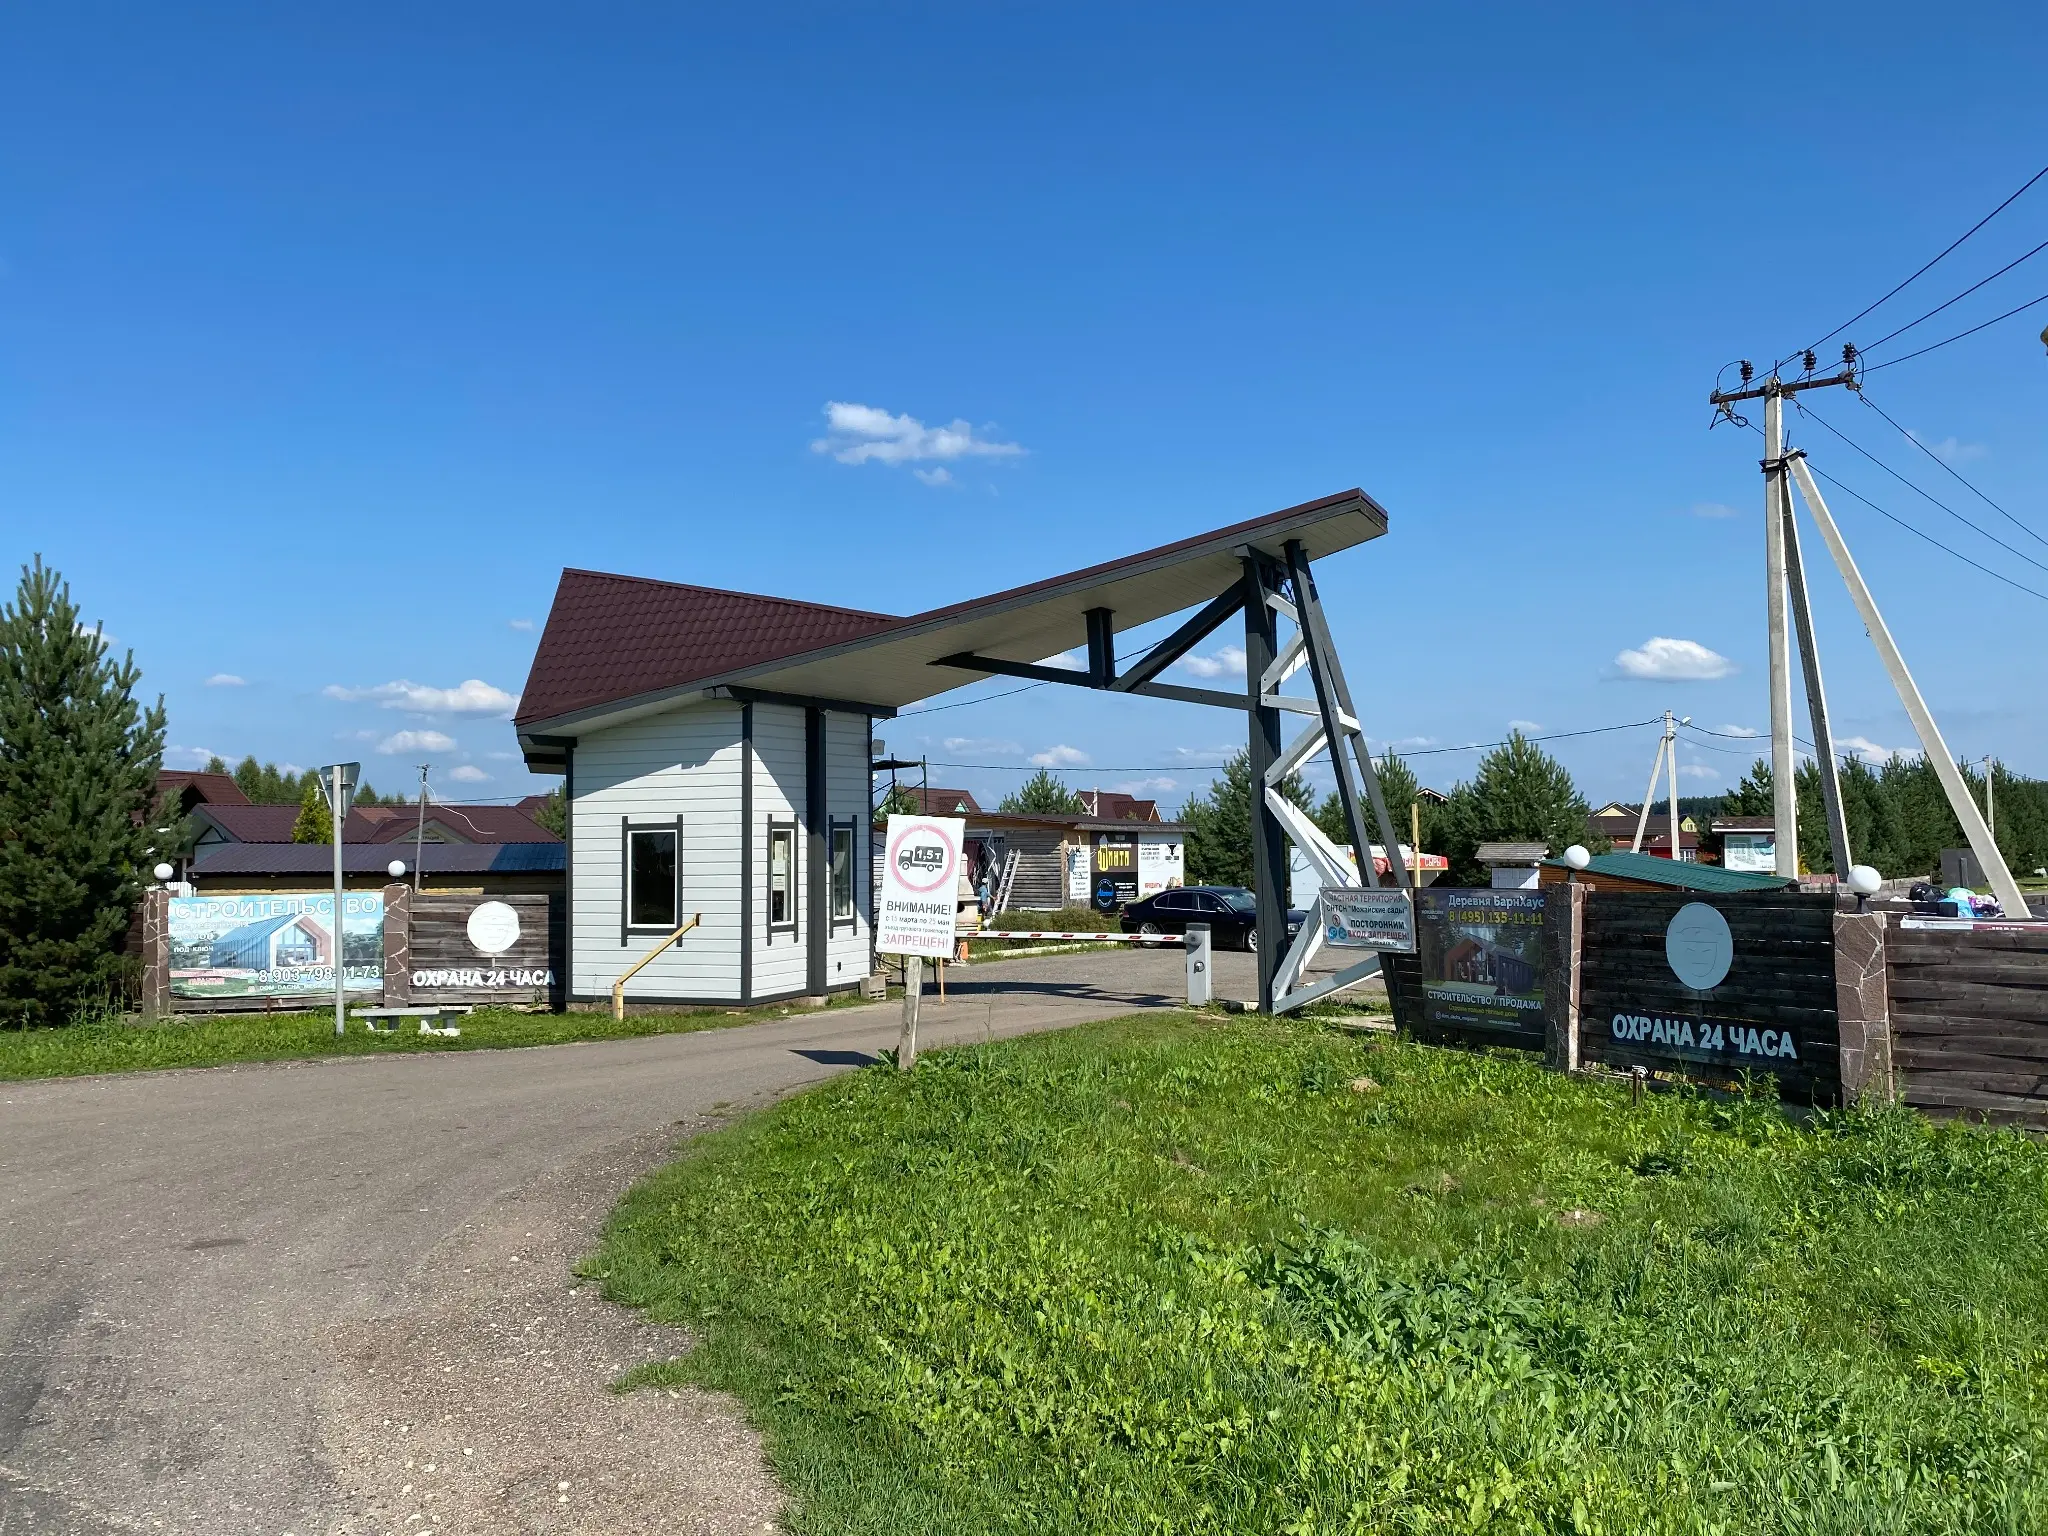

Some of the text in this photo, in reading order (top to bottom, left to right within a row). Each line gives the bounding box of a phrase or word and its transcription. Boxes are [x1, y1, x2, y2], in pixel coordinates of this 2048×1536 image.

[917, 849, 934, 860] 1,5
[1329, 894, 1403, 904] ЧАСТНАЯ ТЕРРИТОРИЯ
[1448, 894, 1545, 910] Деревня БарнХаус
[886, 900, 952, 916] ВНИМАНИЕ!
[1350, 920, 1405, 930] ПОСТОРОННИМ
[1449, 910, 1544, 925] 8 (495) 135-11-11
[883, 933, 949, 949] ЗАПРЕЩЕН!
[1347, 930, 1367, 940] ВХОД
[258, 969, 269, 983] 8
[271, 967, 301, 982] 903
[412, 970, 556, 987] ОХРАНА 24 ЧАСА
[1427, 990, 1492, 1005] СТРОИТЕЛЬСТВО
[1499, 997, 1542, 1010] ПРОДАЖА
[1612, 1013, 1798, 1060] ОХРАНА 24 ЧАСА
